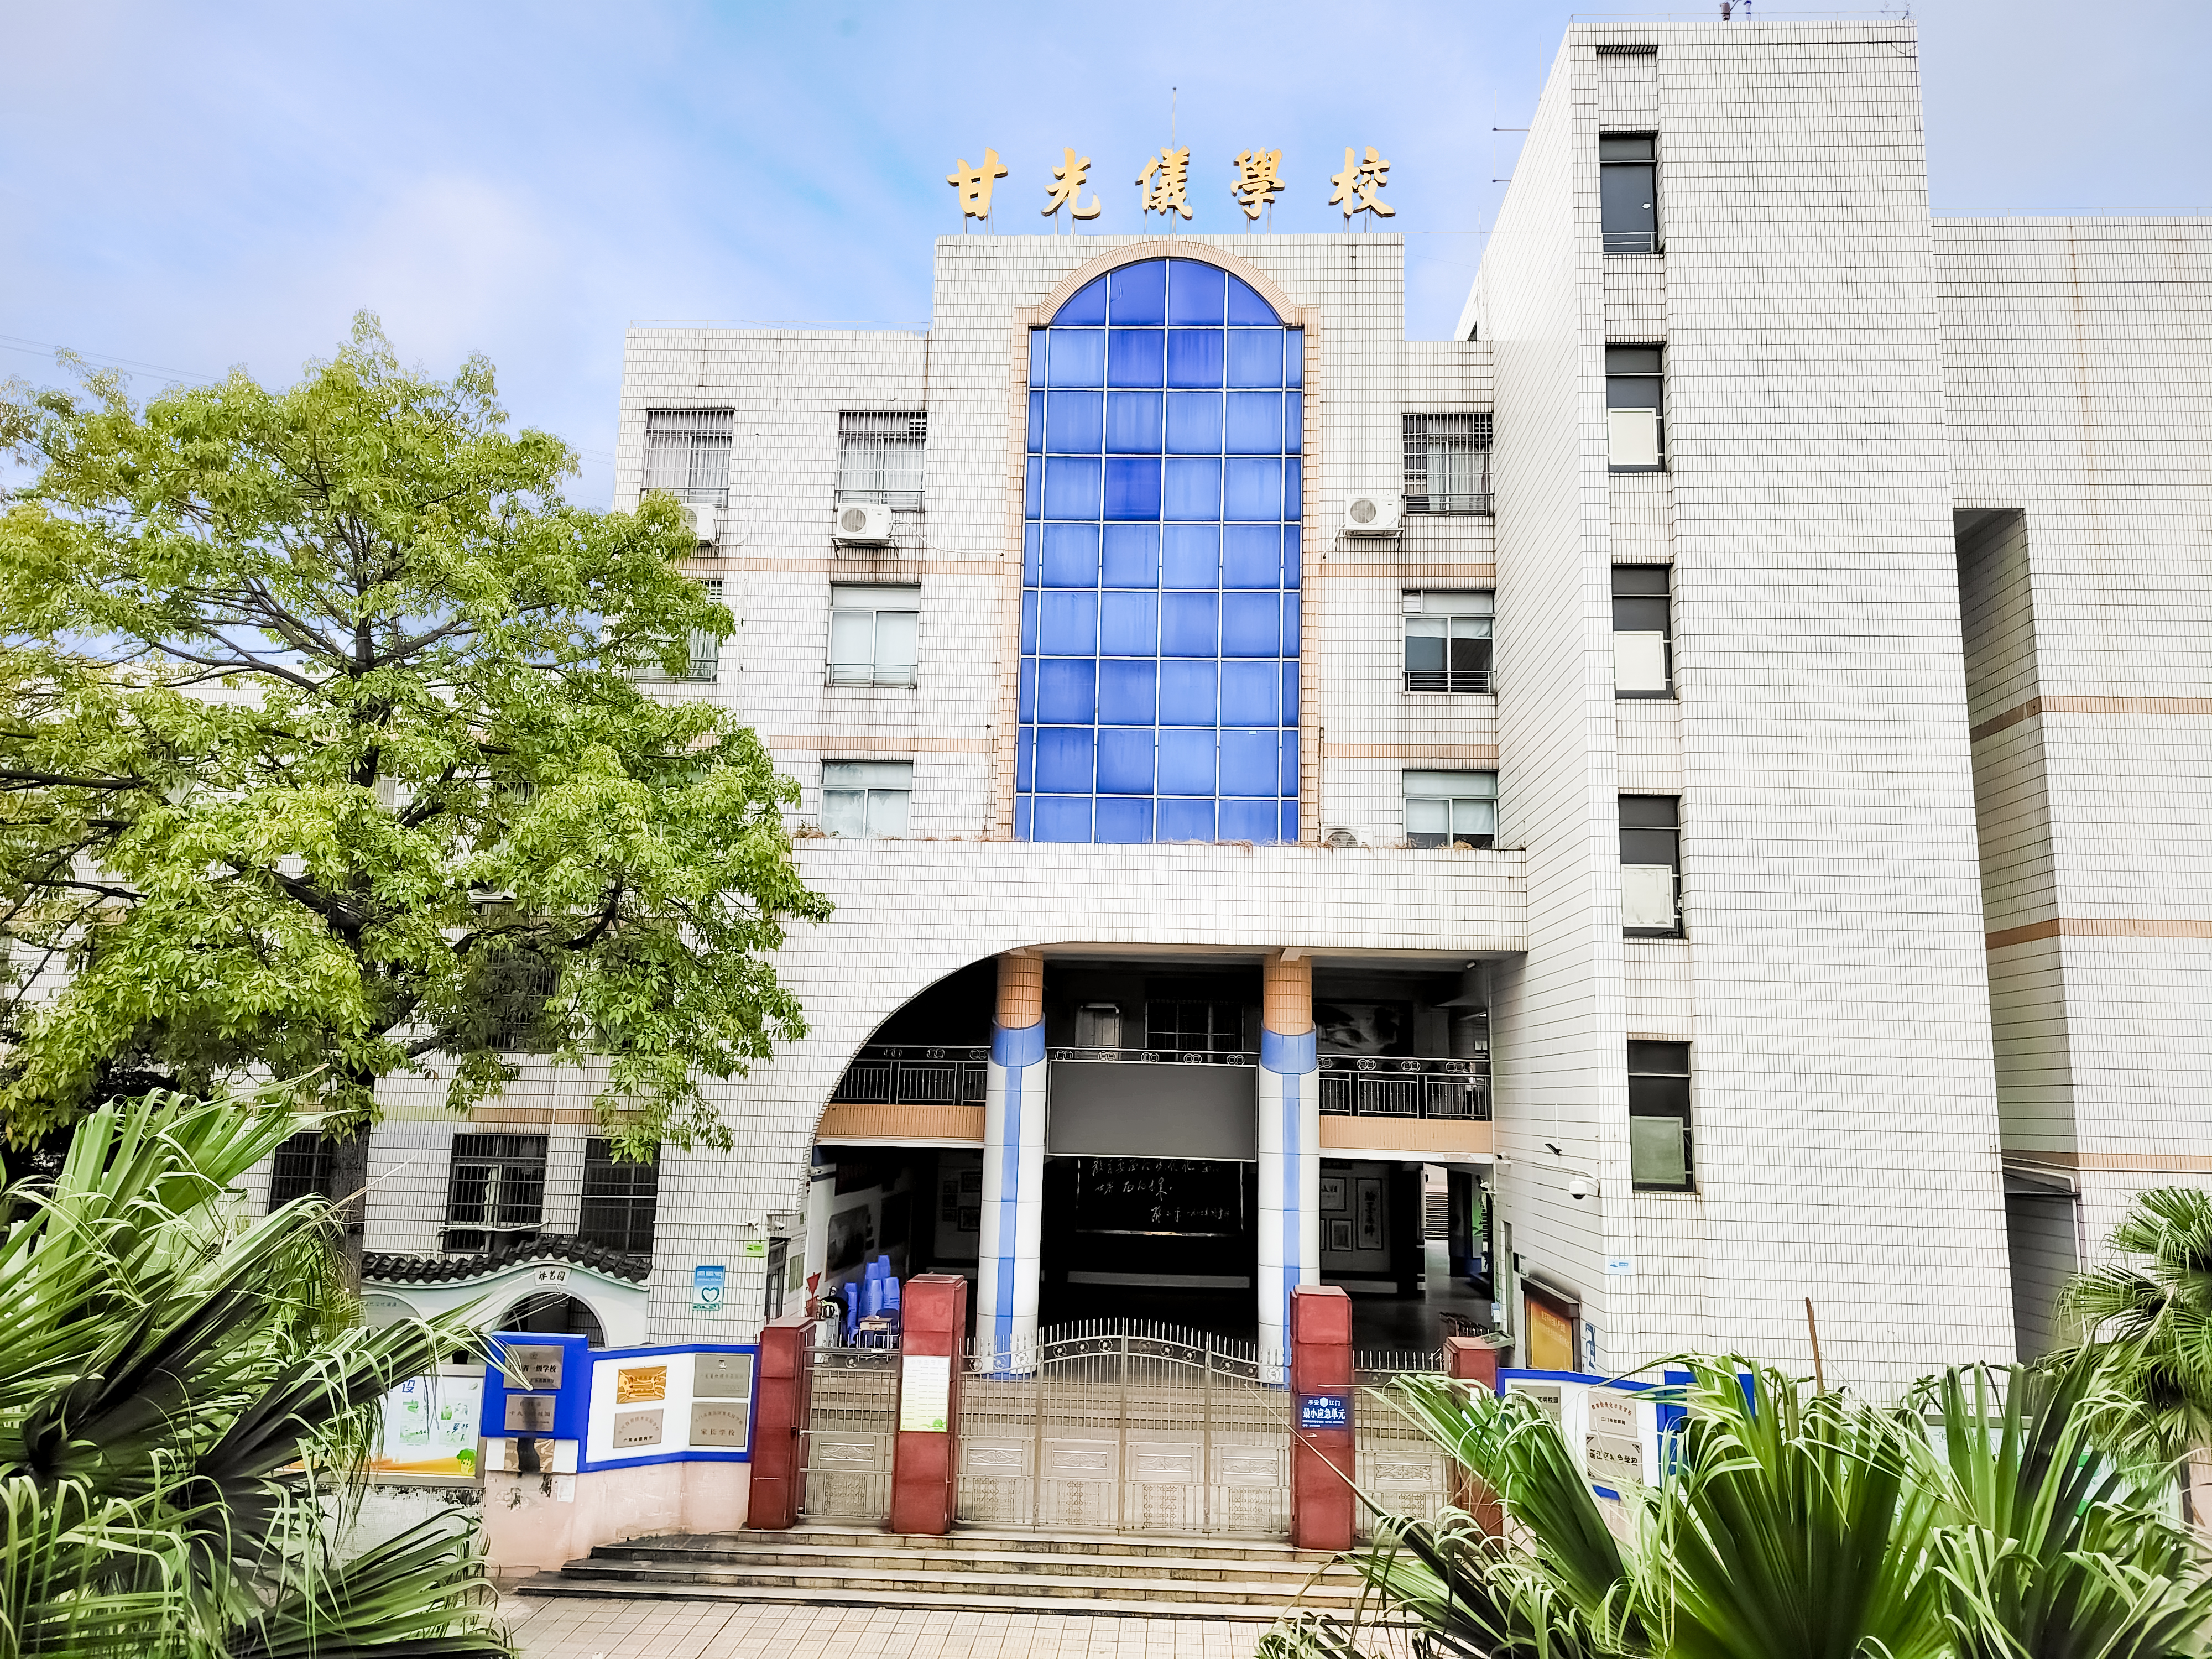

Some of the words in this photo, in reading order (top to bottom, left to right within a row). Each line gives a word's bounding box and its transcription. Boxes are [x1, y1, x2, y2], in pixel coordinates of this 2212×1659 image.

[946, 145, 1396, 220] 甘光儀學校
[1303, 1407, 1346, 1420] 最小应急单元
